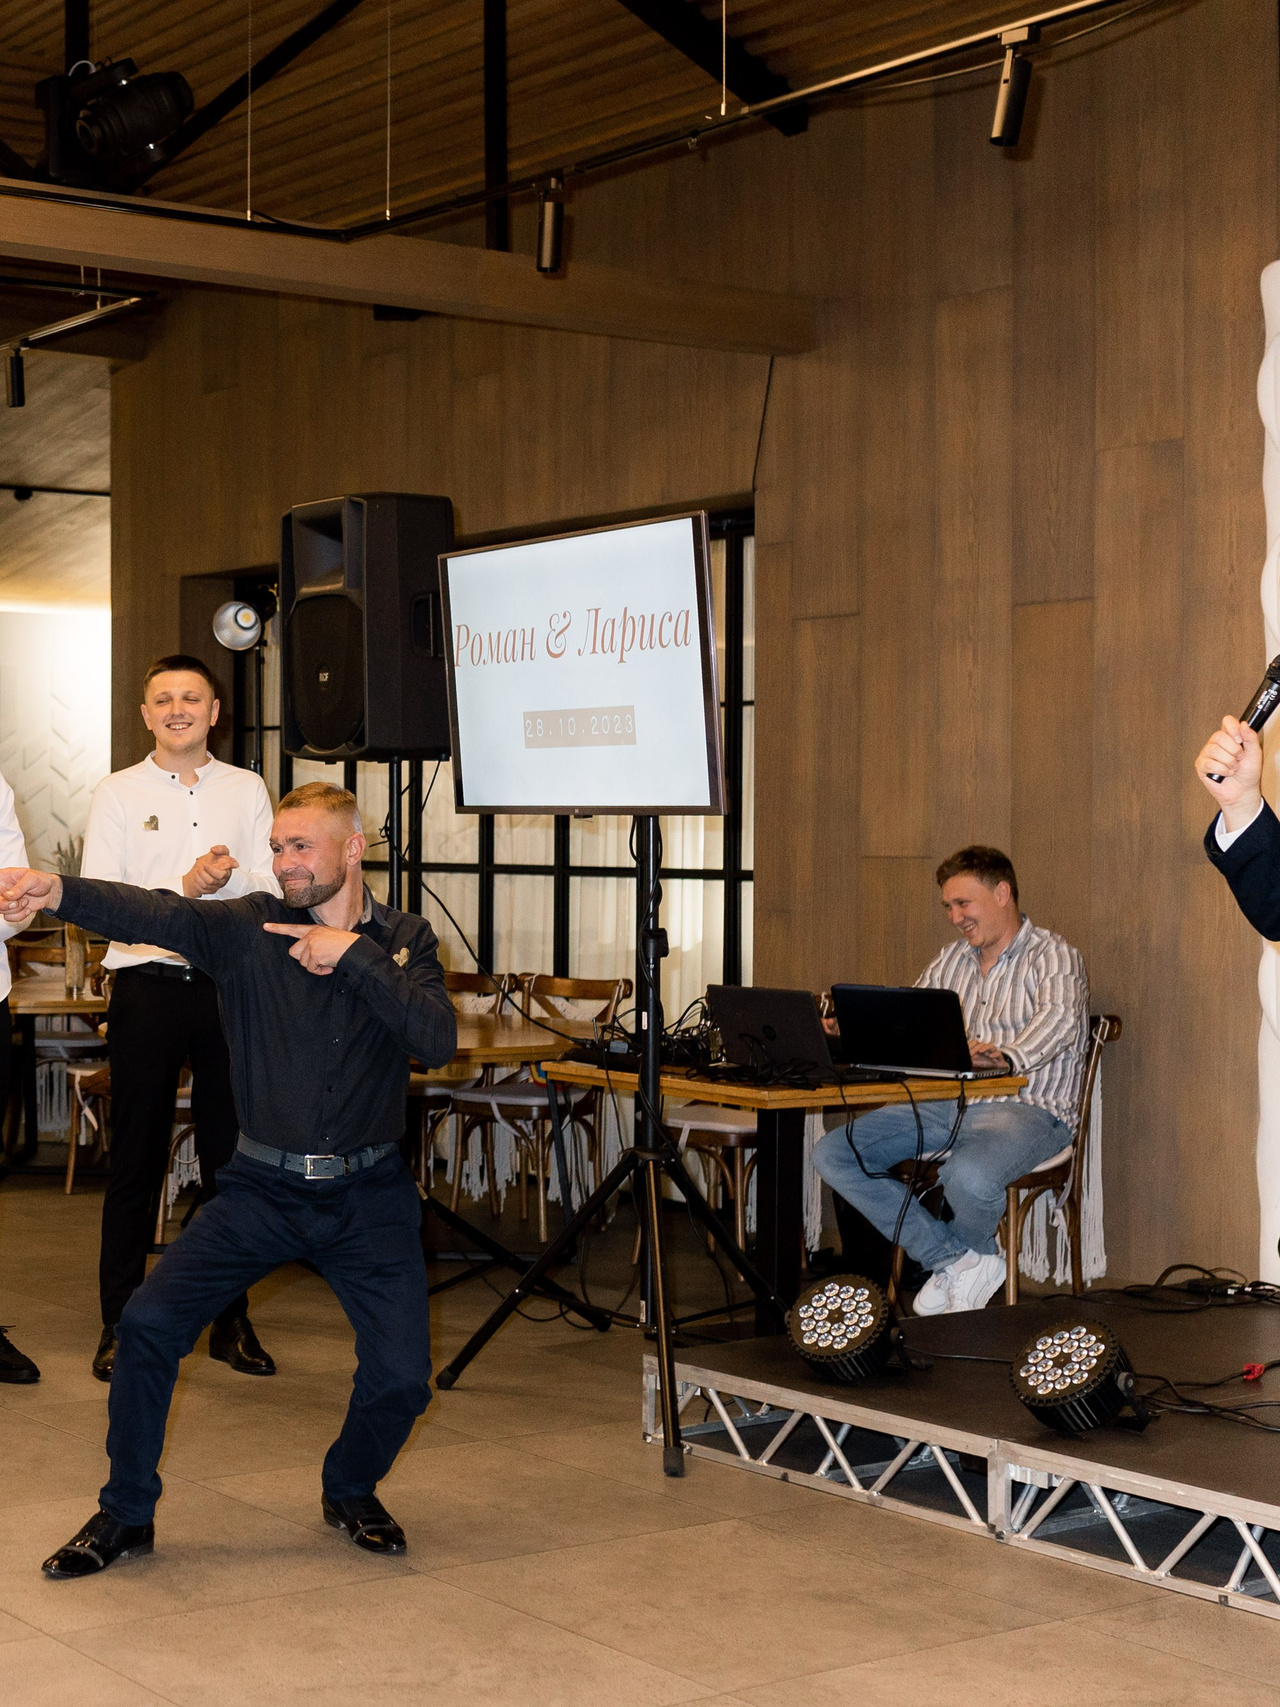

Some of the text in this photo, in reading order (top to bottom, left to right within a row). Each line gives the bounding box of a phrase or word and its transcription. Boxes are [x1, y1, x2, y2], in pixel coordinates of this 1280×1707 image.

[455, 606, 692, 667] Роман & Лариса
[525, 713, 633, 738] 28.10.2023
